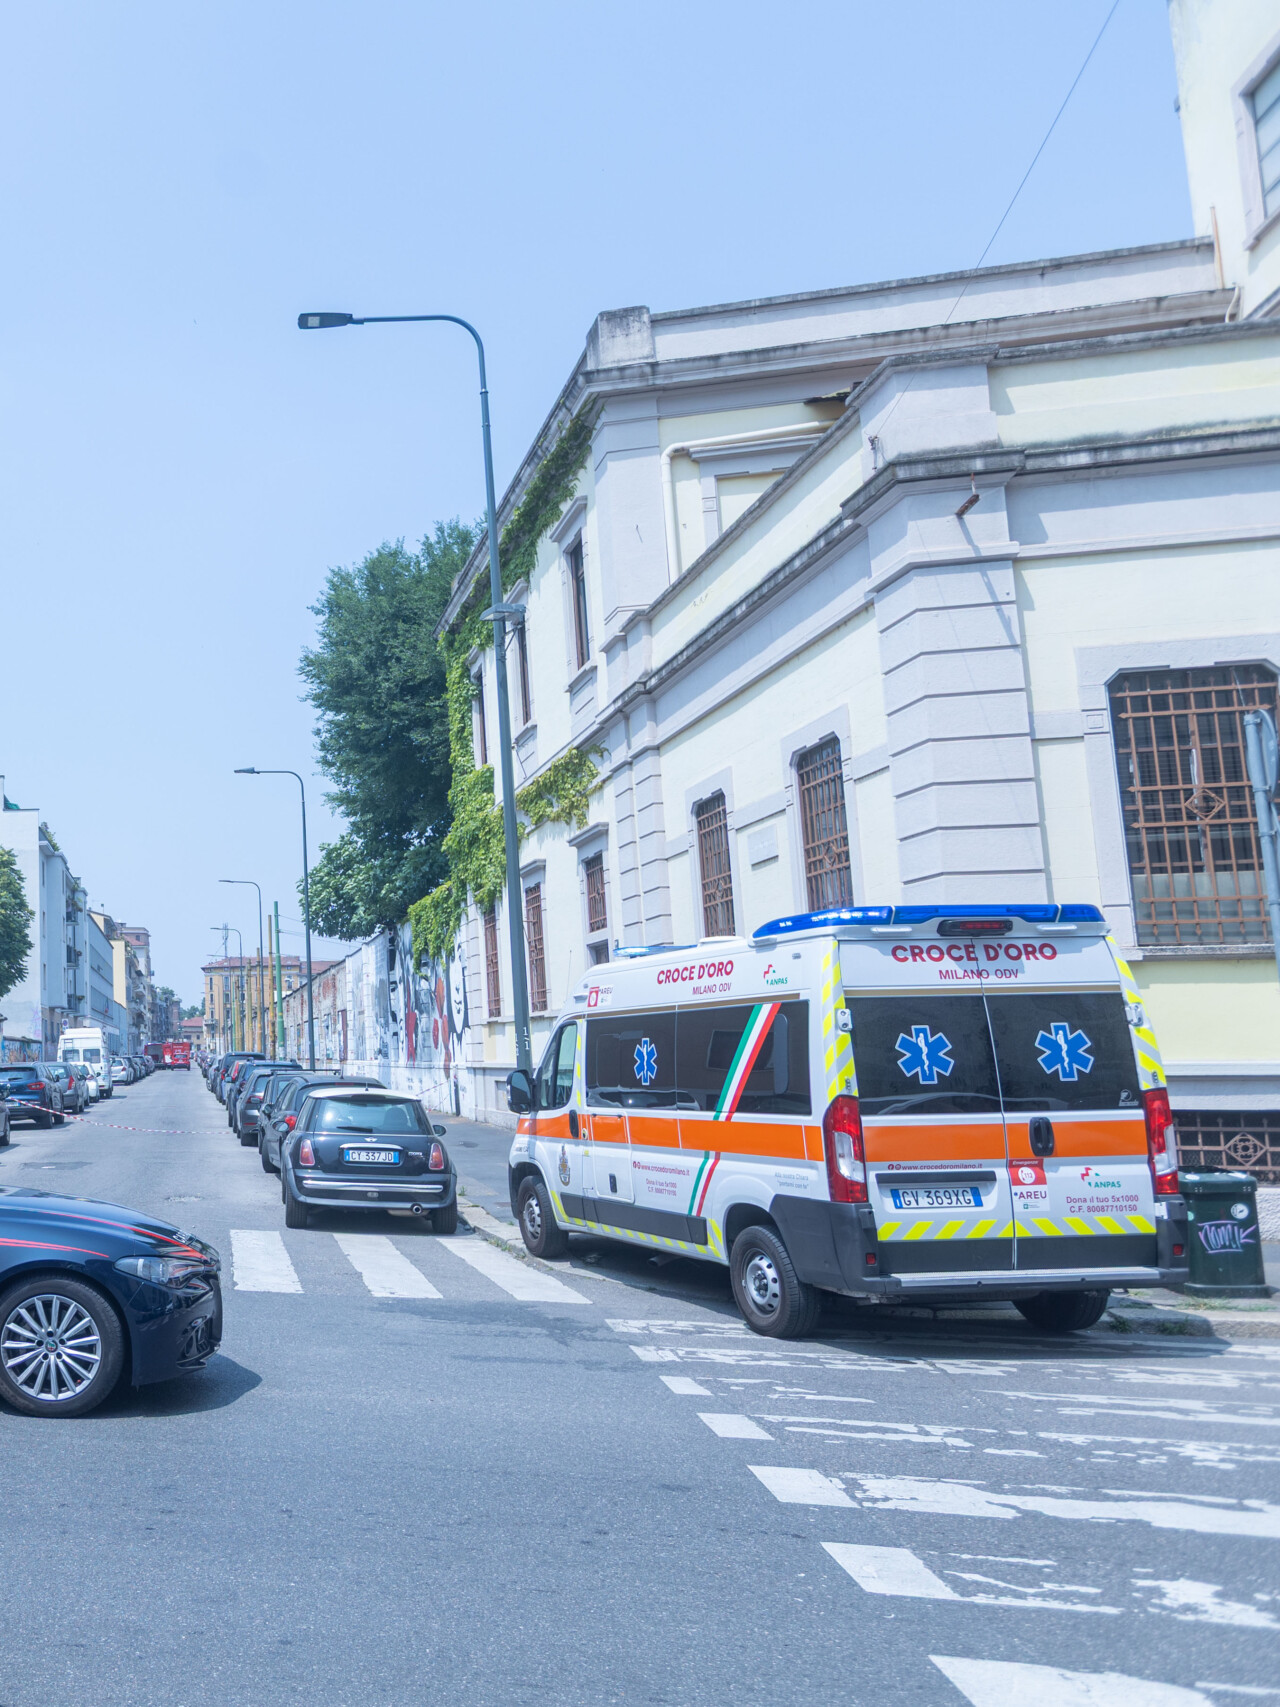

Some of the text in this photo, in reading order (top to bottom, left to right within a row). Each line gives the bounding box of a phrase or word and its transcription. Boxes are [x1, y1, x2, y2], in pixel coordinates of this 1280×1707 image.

[890, 942, 1058, 963] CROCE D'ORO
[656, 960, 734, 985] CROCE D'ORO
[938, 968, 1019, 980] MILANO ODV
[769, 977, 788, 986] ANPAS
[692, 982, 732, 995] MILANO ODV
[350, 1151, 361, 1161] CY
[902, 1163, 983, 1171] www.crocedoromilano.it
[901, 1189, 920, 1207] GV
[1018, 1190, 1047, 1200] AREU
[1066, 1194, 1139, 1204] Dona il tuo 5x1000
[1069, 1204, 1138, 1214] C.F. 80087710150
